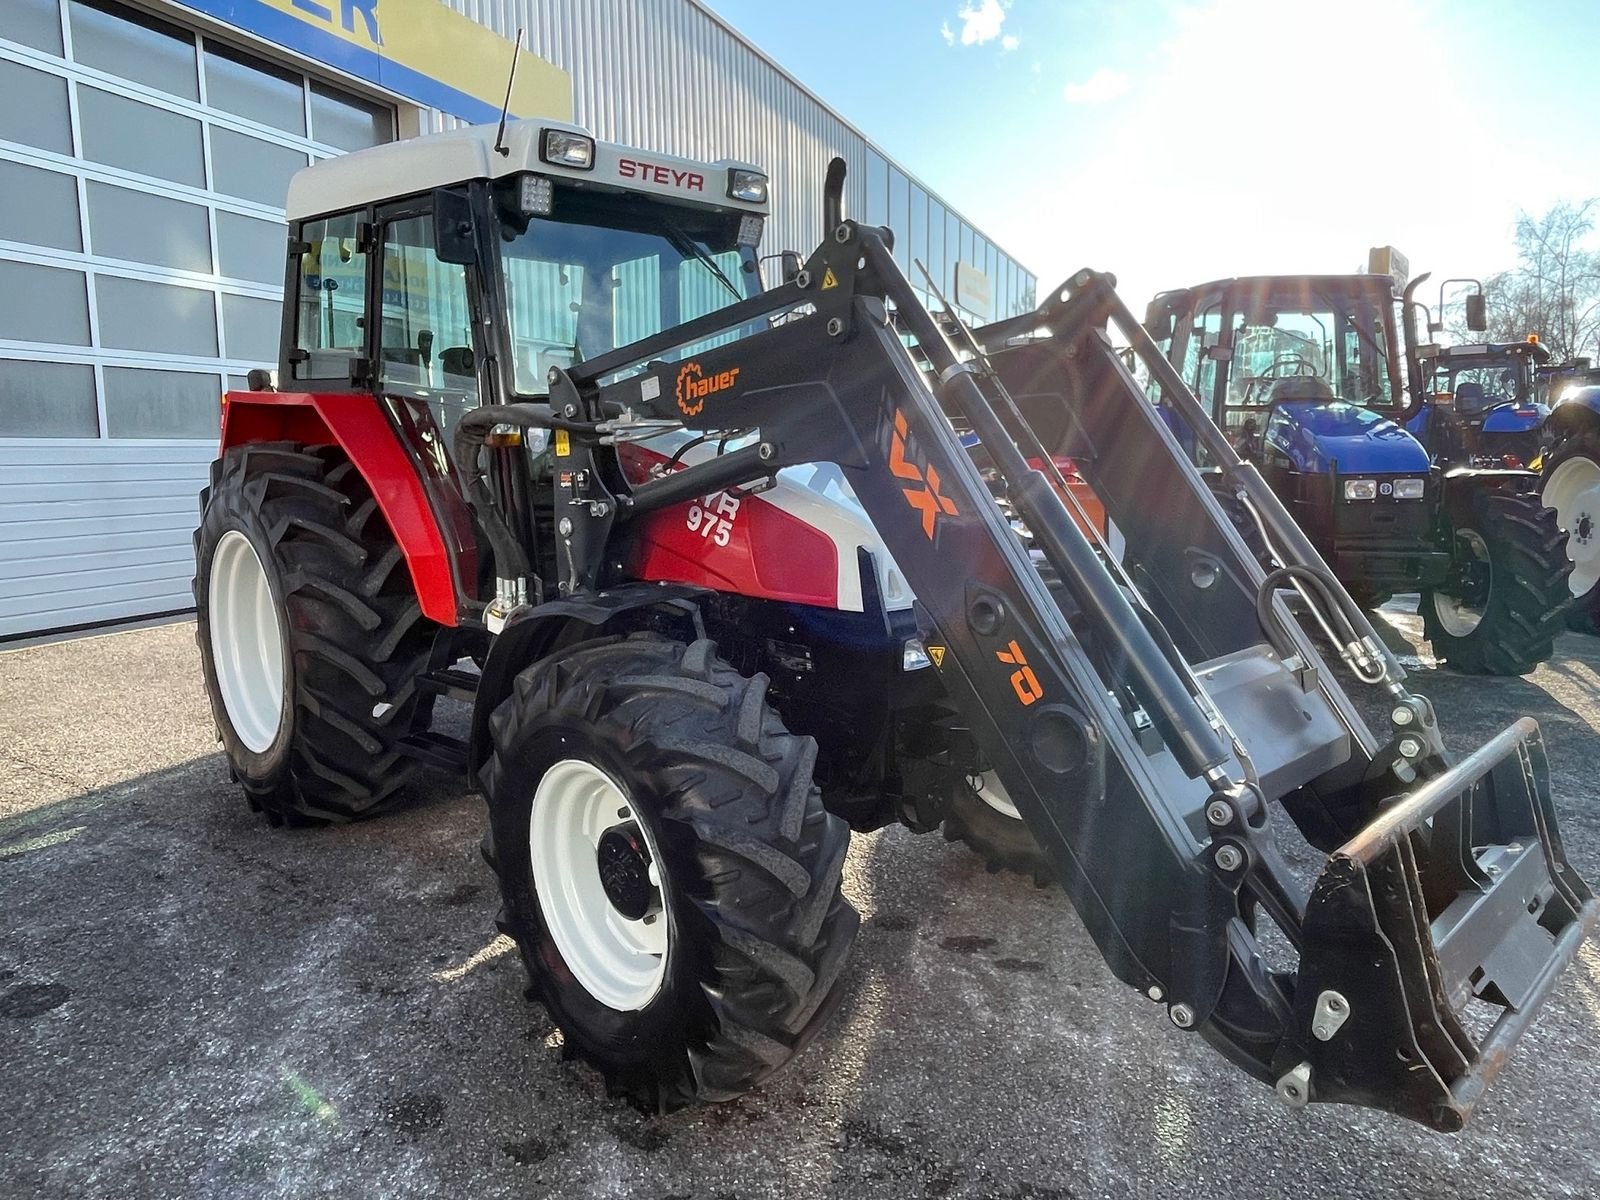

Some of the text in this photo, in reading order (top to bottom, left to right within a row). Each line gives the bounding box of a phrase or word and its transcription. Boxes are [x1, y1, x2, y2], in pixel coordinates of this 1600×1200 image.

[619, 159, 704, 191] STEYR
[686, 368, 740, 400] hauer
[686, 505, 733, 547] 975
[996, 639, 1043, 706] 70
